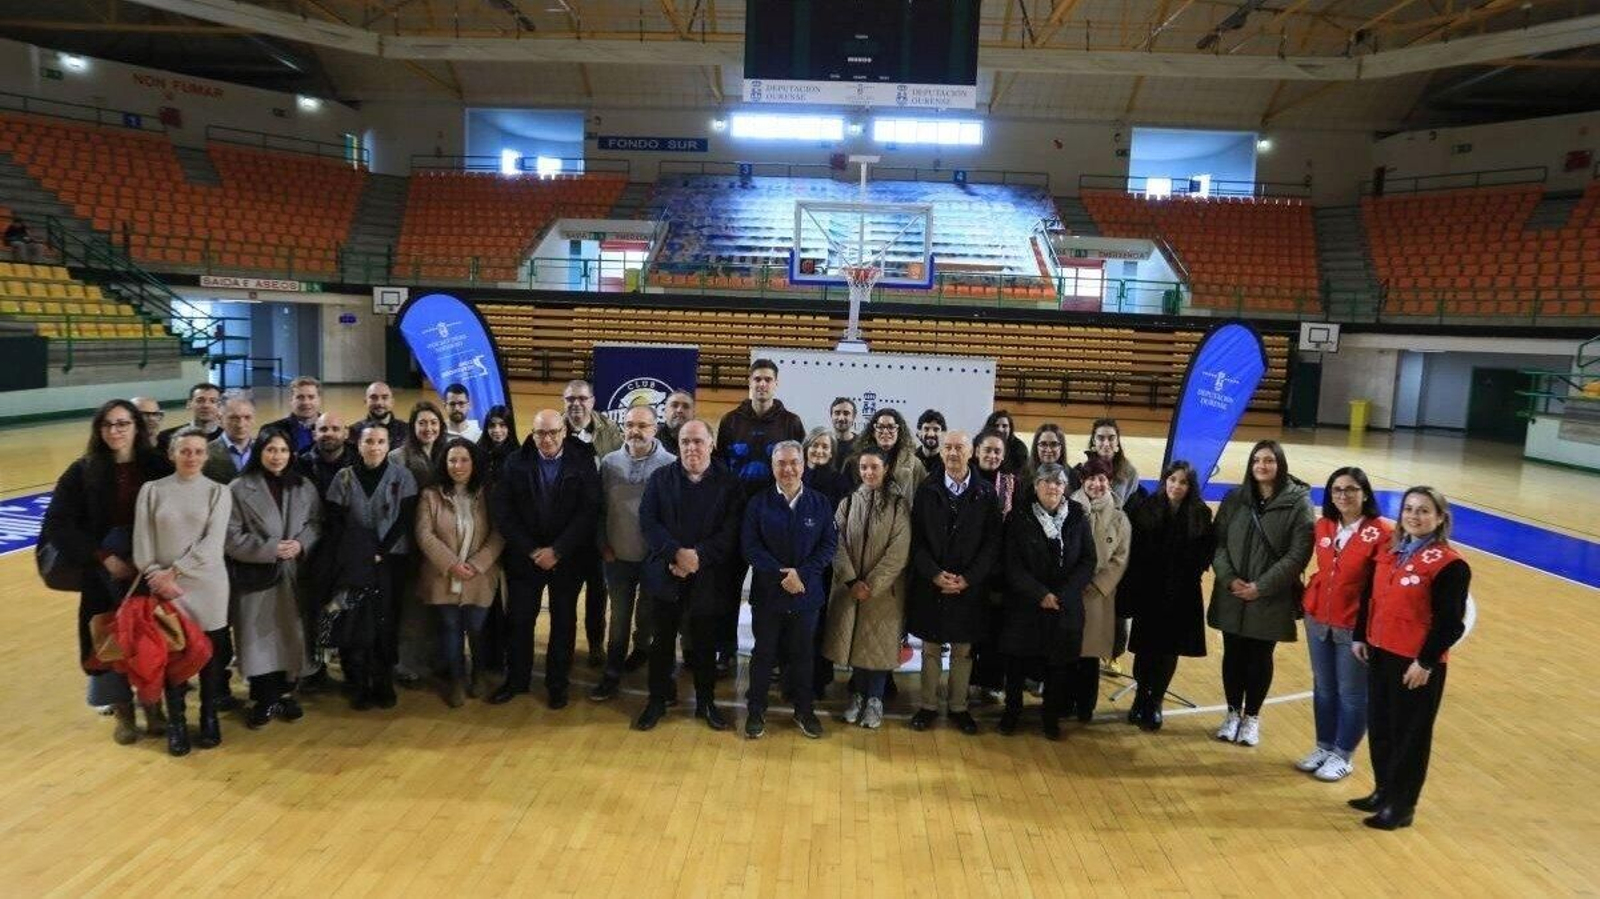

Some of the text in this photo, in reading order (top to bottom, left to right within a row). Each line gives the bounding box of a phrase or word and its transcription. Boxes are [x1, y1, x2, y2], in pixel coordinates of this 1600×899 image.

[133, 73, 224, 98] NON FUMAR
[608, 139, 699, 150] FONDO SUR
[243, 278, 249, 288] E
[255, 279, 298, 290] ASEOS
[627, 380, 656, 390] CLUB
